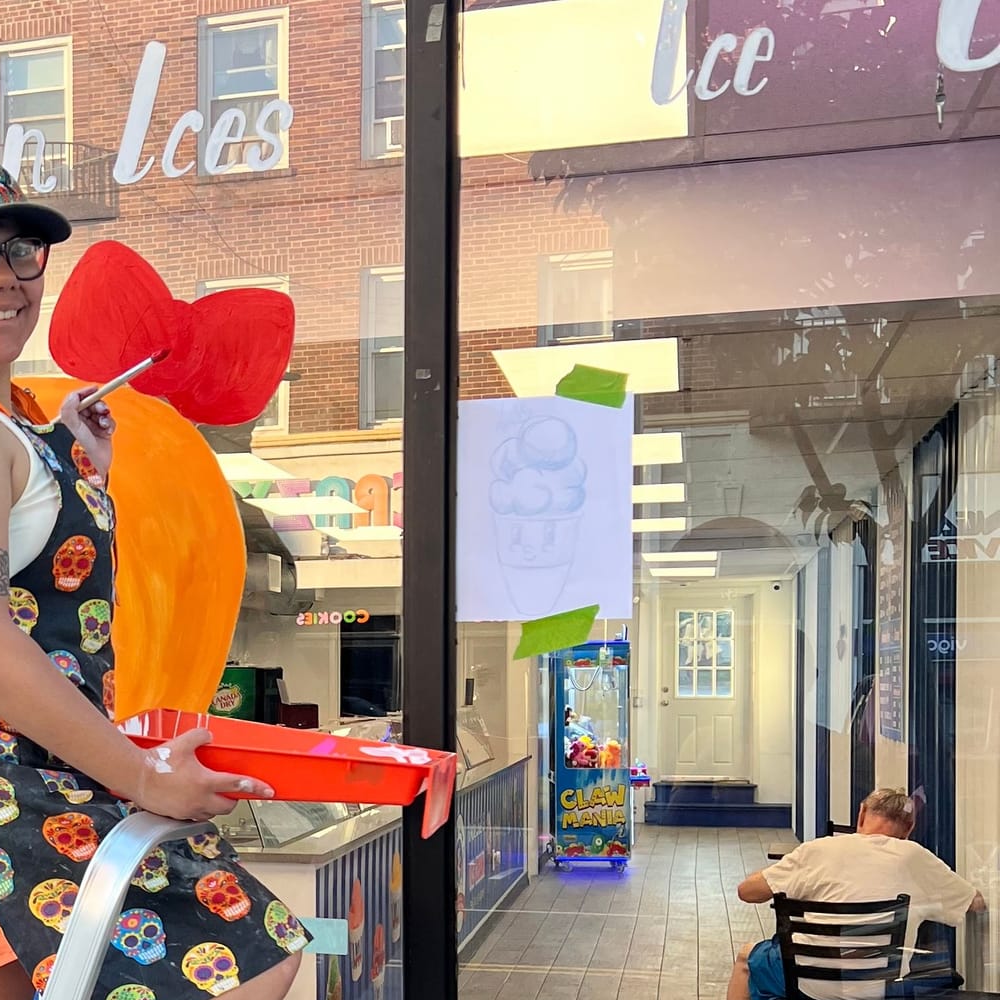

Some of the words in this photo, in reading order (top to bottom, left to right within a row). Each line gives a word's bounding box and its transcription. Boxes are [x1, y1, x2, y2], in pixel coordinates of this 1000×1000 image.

[651, 0, 776, 105] Ice
[113, 41, 293, 184] Ices
[560, 783, 627, 813] CLAW
[561, 808, 627, 830] MANIA
